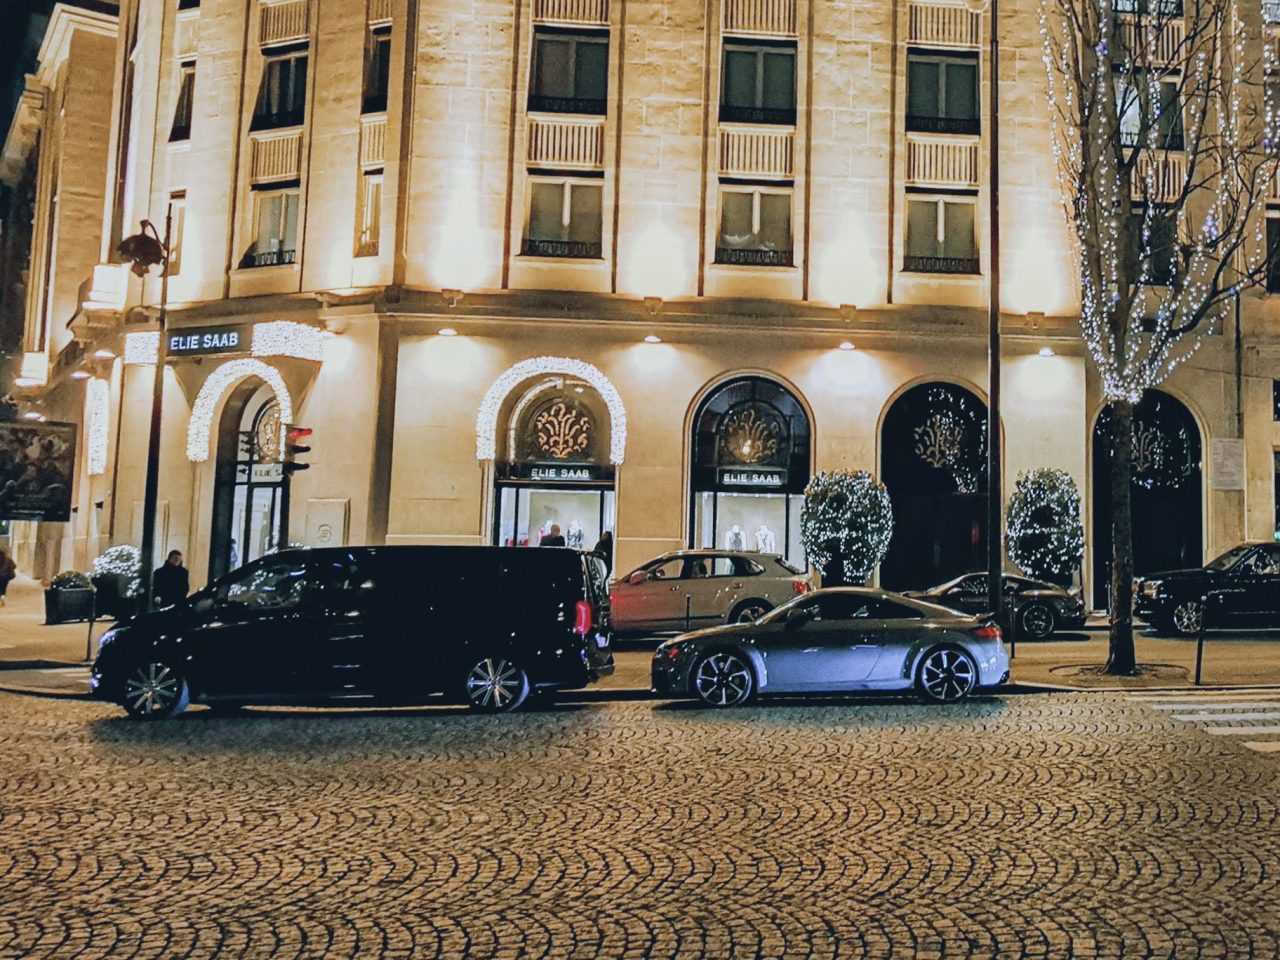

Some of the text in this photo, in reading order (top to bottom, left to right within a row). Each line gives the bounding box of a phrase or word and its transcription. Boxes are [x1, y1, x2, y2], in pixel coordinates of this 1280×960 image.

[170, 331, 239, 351] ELIE SAAB
[531, 468, 590, 479] ELIE SAAB
[723, 472, 781, 483] ELIE SAAB
